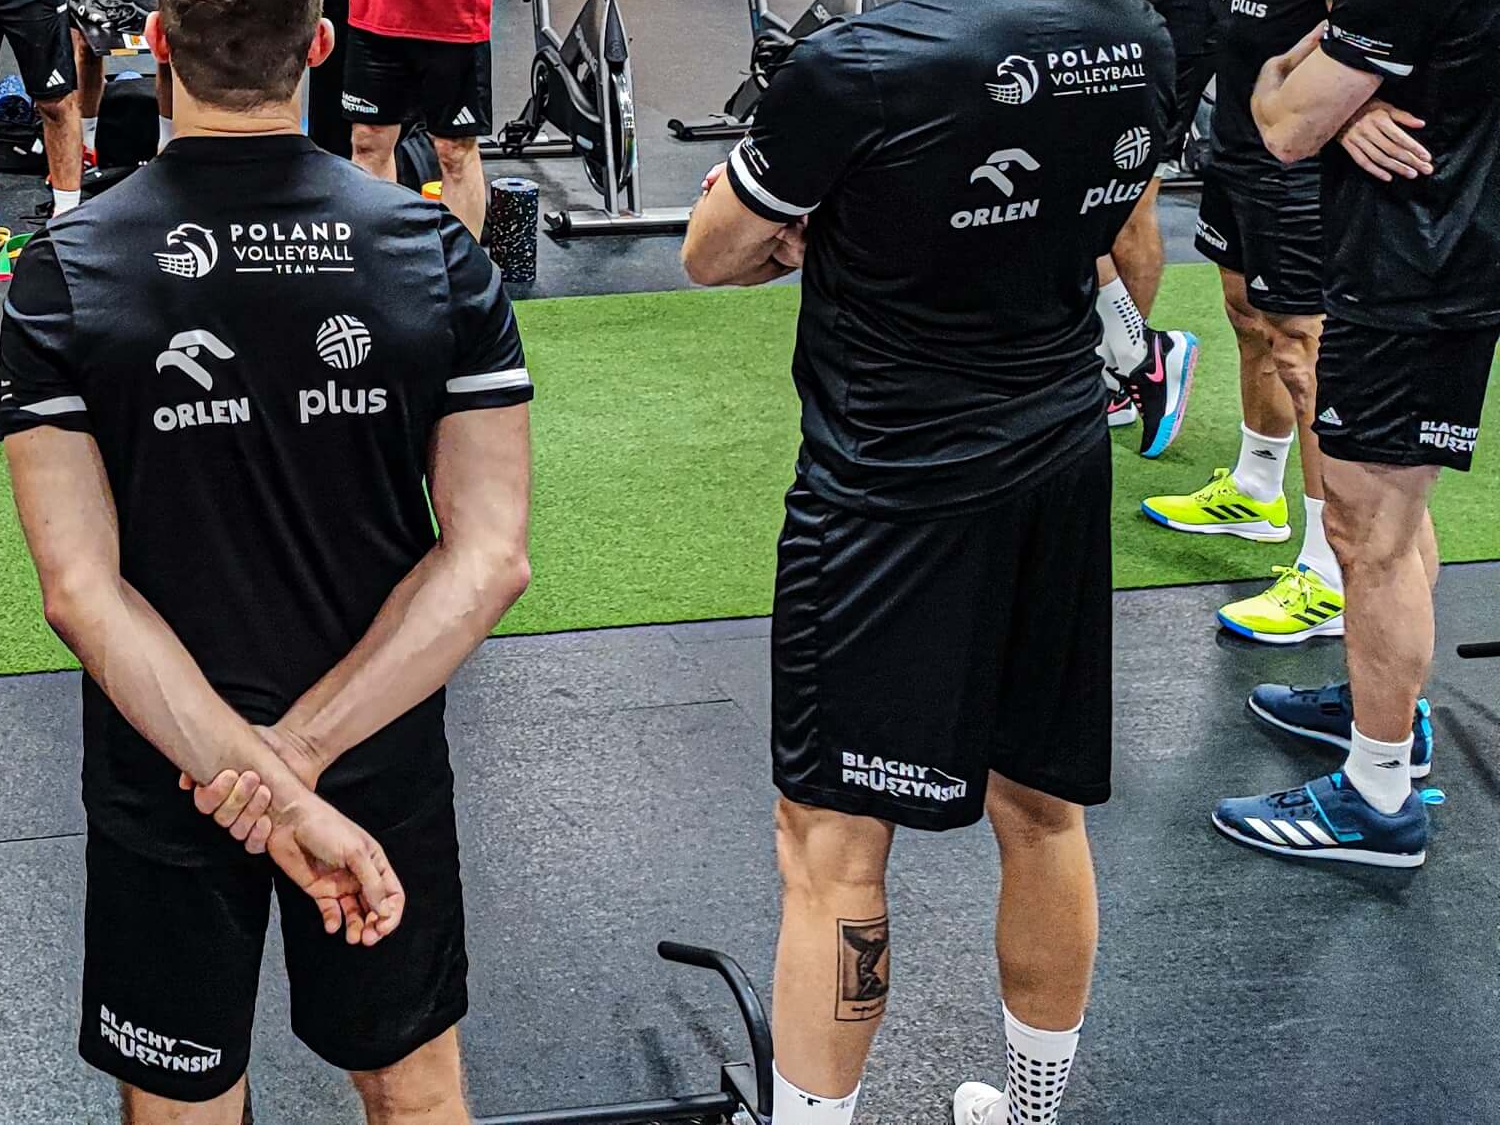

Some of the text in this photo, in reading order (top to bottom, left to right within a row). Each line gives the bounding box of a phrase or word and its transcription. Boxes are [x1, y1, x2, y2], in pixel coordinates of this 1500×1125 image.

[1047, 42, 1143, 69] POLAND
[1050, 63, 1146, 86] VOLLEYBALL
[1085, 83, 1119, 95] TEAM
[1079, 178, 1148, 214] plus
[950, 198, 1040, 229] ORLEN
[229, 222, 352, 242] POLAND
[232, 245, 354, 261] VOLLEYBALL
[275, 264, 316, 274] TEAM
[153, 396, 250, 431] ORLEN
[299, 380, 387, 424] plus
[841, 751, 930, 779] BLACHY
[842, 768, 967, 802] PRUSZYŃSKI
[100, 1004, 177, 1052] BLACHY
[100, 1022, 221, 1073] PRUSZYŃSKI
